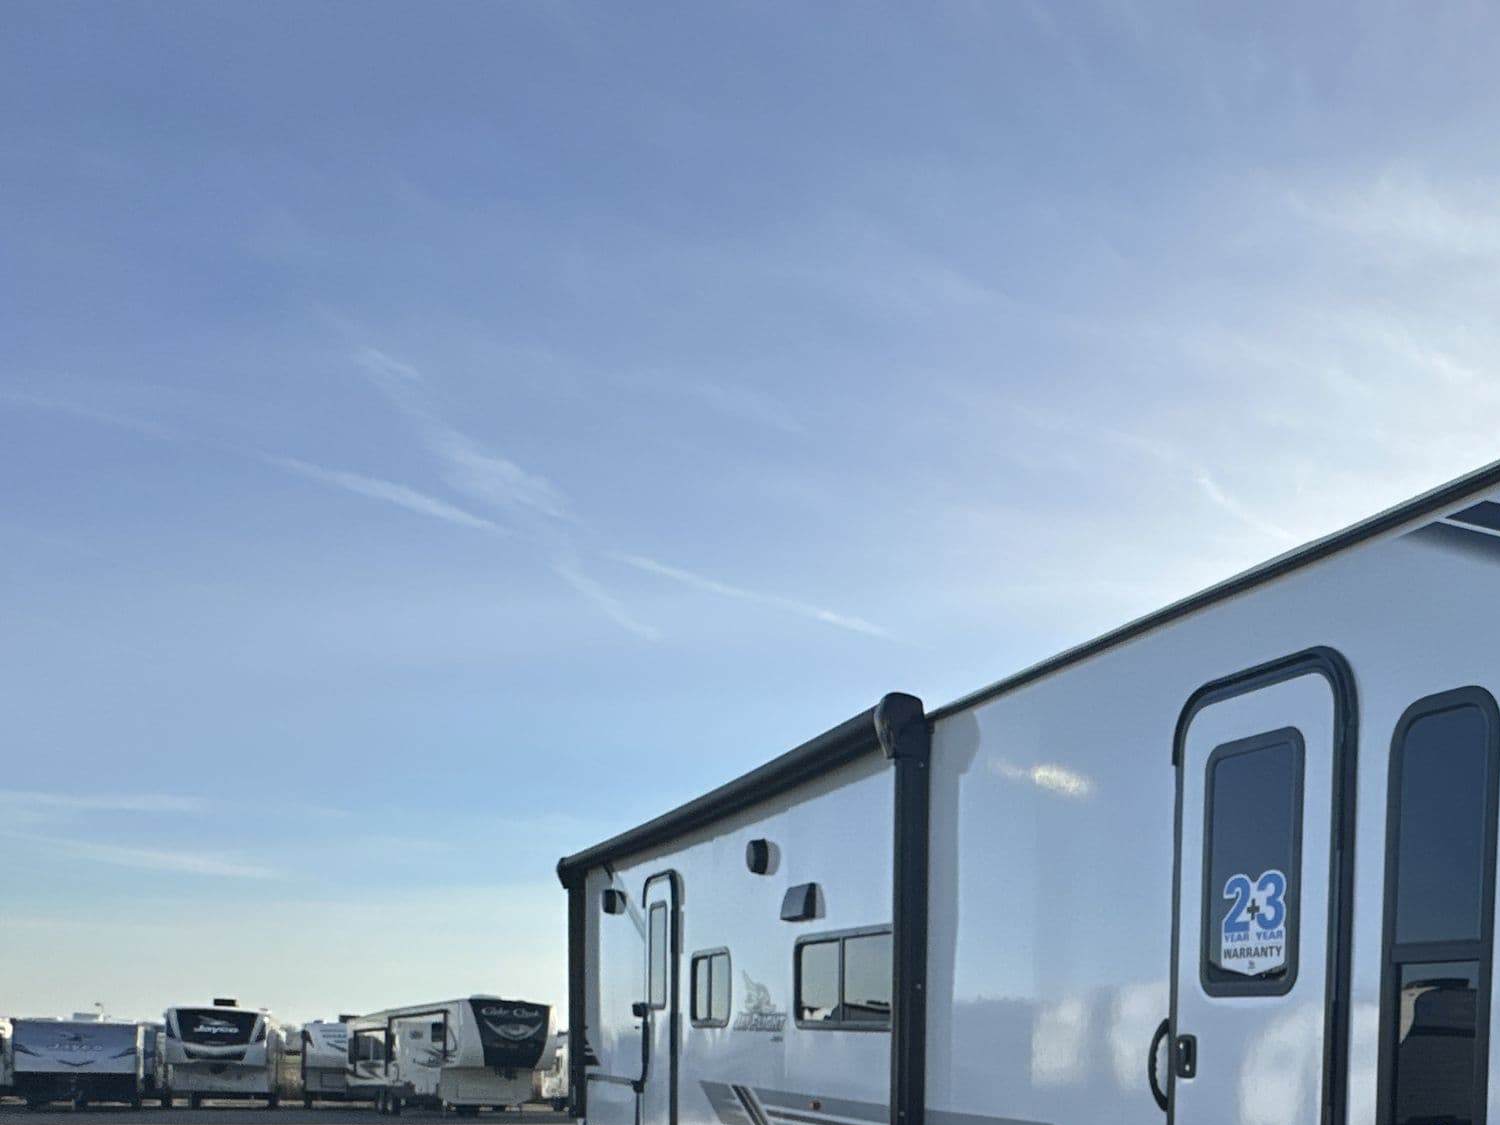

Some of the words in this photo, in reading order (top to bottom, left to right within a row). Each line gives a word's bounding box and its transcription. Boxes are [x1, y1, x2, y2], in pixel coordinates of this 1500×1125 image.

[1224, 933, 1249, 942] YEAR
[1256, 930, 1283, 941] YEAR
[1223, 945, 1283, 959] WARRANTY
